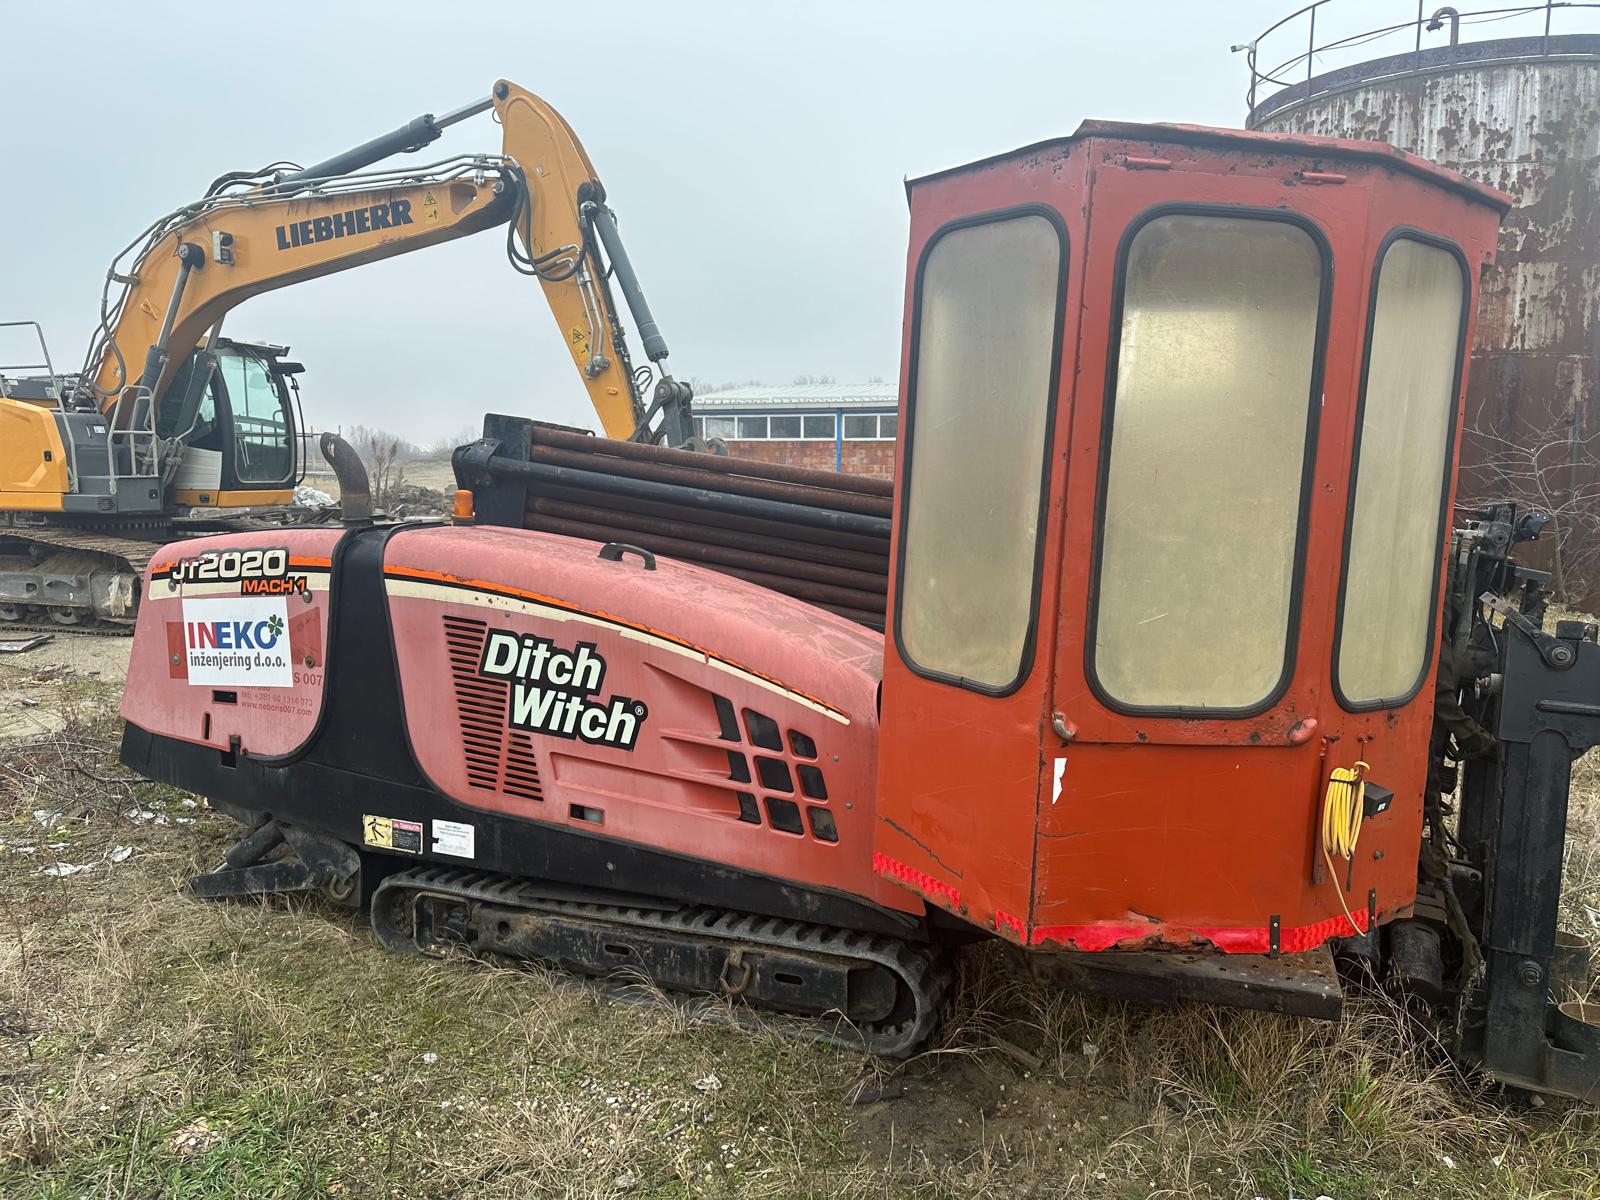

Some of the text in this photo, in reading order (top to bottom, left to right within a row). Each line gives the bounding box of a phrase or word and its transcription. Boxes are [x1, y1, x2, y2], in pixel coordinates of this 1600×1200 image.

[275, 199, 414, 250] LIEBHERR
[172, 549, 287, 580] JT2020
[243, 579, 306, 593] MACH 1
[188, 620, 279, 650] INEKO
[190, 652, 286, 671] inženjering d.o.o.
[483, 633, 602, 690] Ditch
[303, 673, 323, 687] 007
